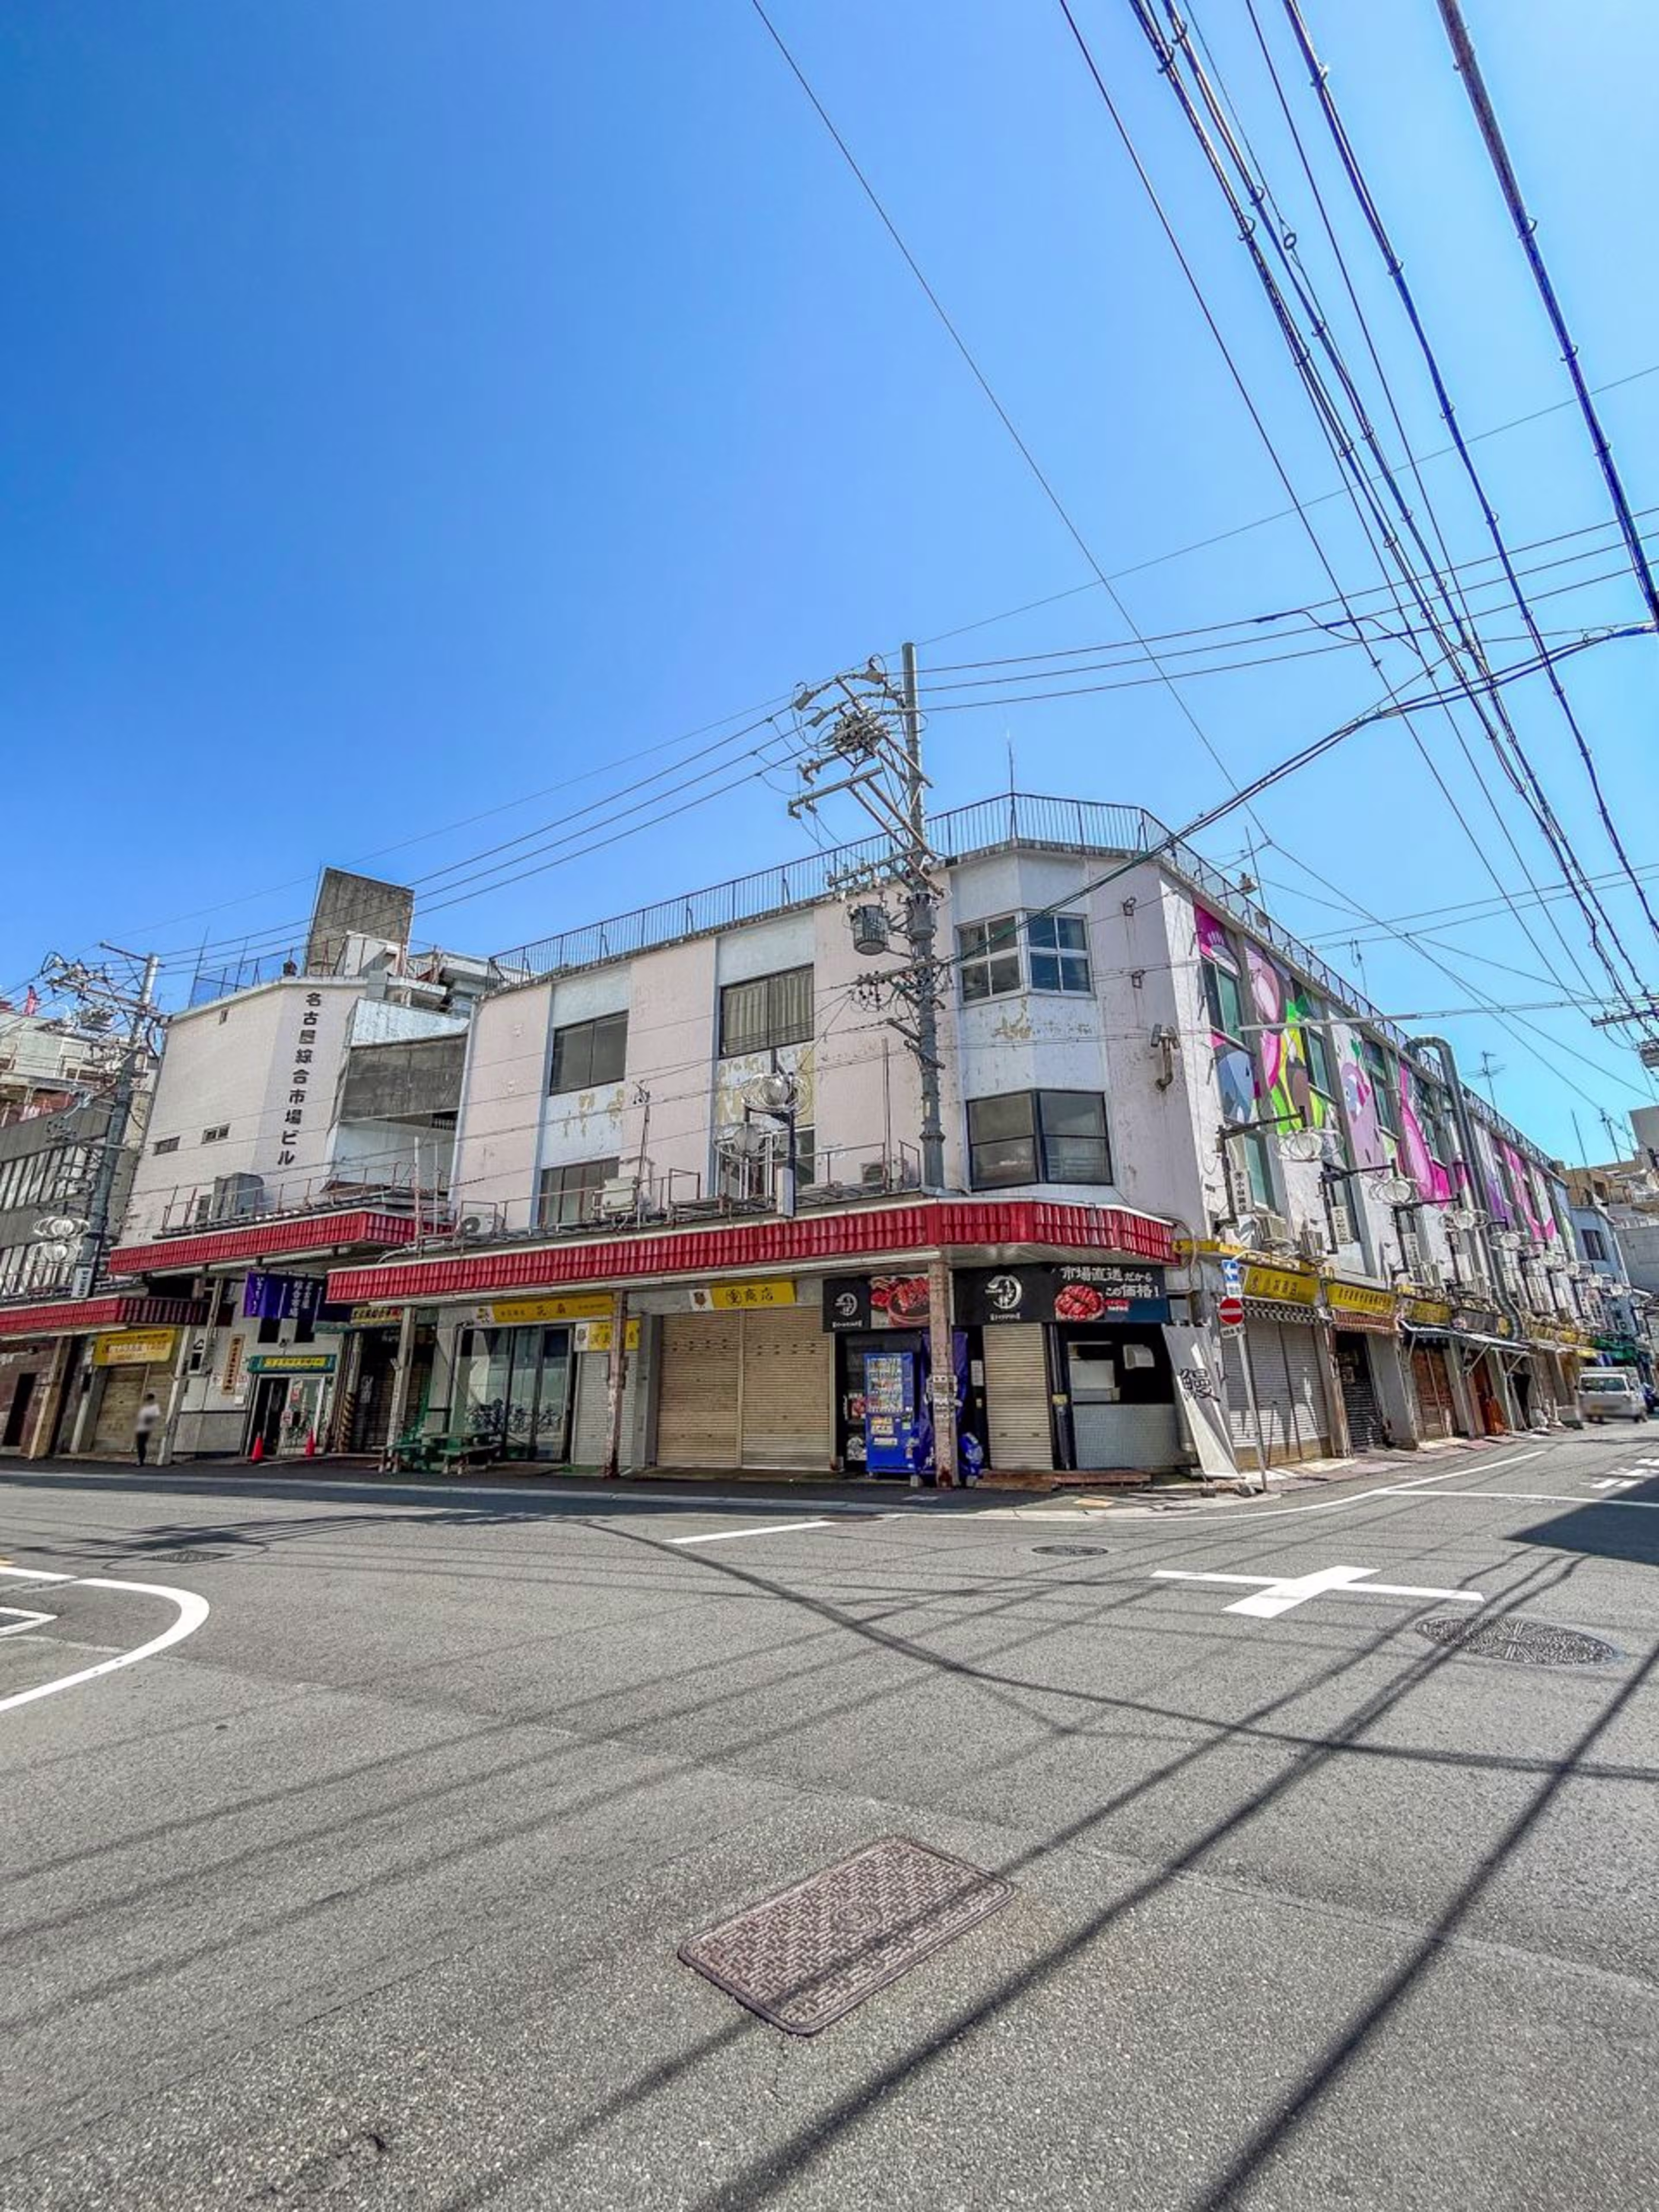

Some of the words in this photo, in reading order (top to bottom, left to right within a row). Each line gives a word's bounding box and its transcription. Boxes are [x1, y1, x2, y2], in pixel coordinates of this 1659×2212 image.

[277, 992, 321, 1165] 名古屋綜合市場ビル
